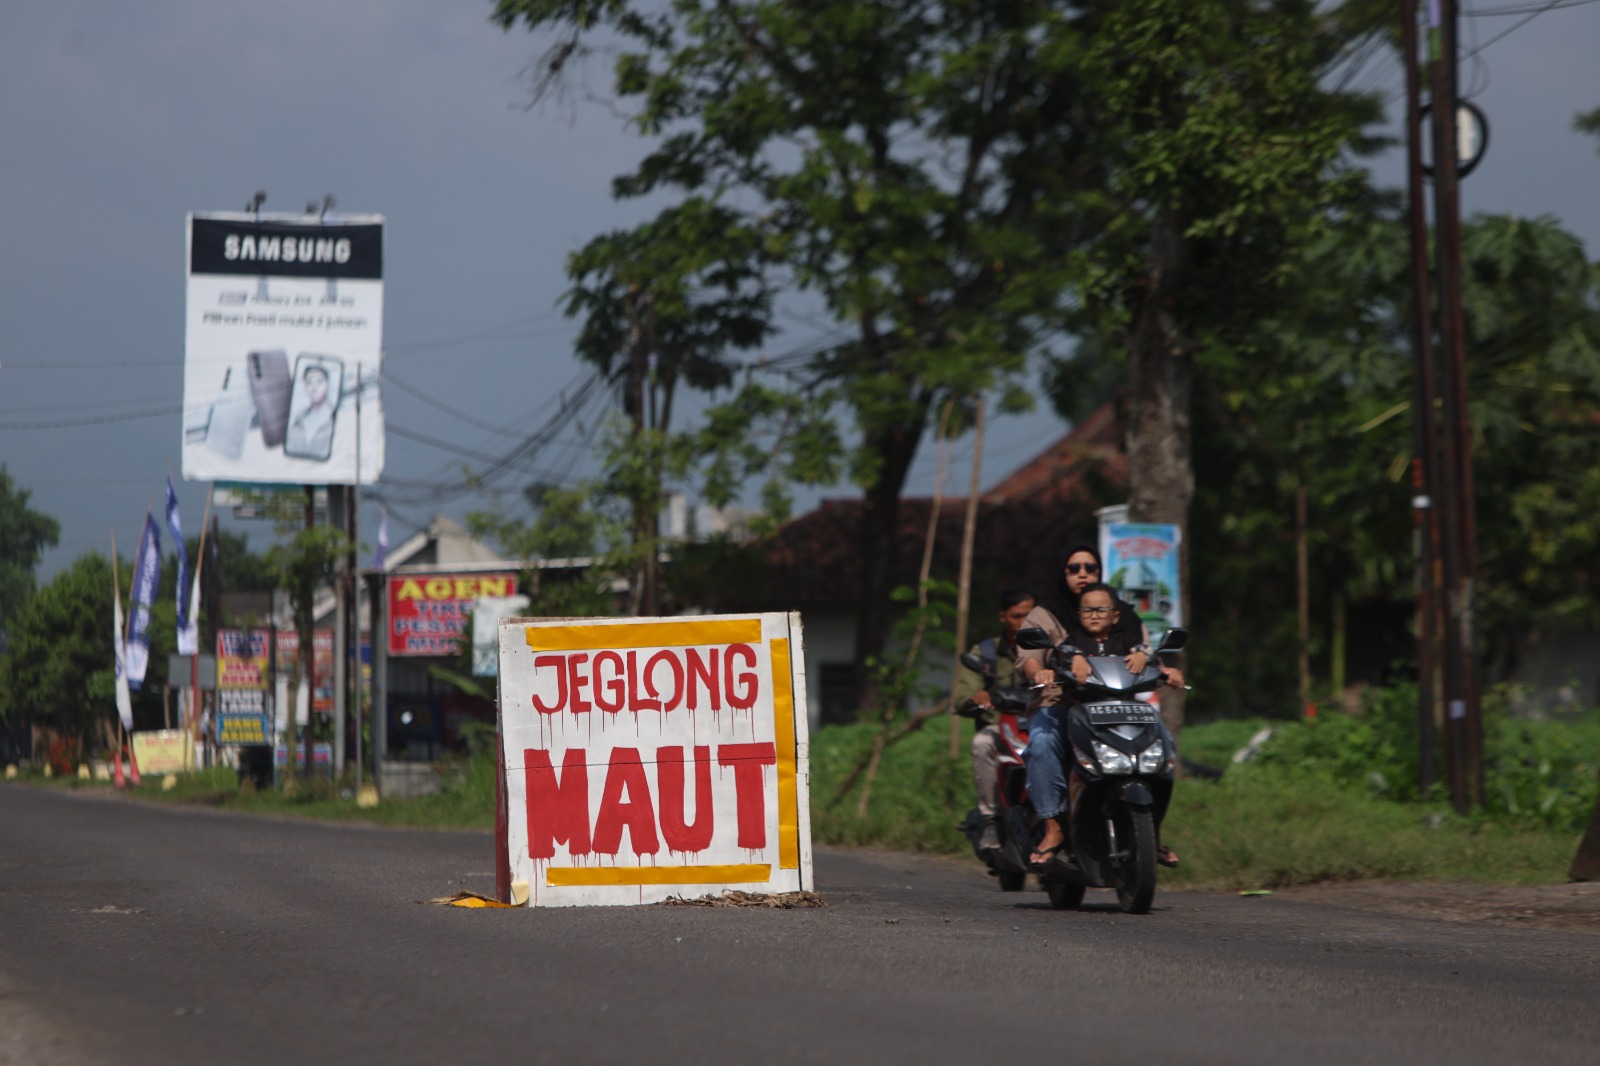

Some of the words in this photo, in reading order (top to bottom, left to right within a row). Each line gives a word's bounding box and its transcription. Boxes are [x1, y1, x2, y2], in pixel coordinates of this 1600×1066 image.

[224, 234, 351, 263] SAMSUNG
[396, 576, 507, 600] AGEN
[532, 643, 758, 714] JEGLONG
[524, 742, 777, 860] MAUT
